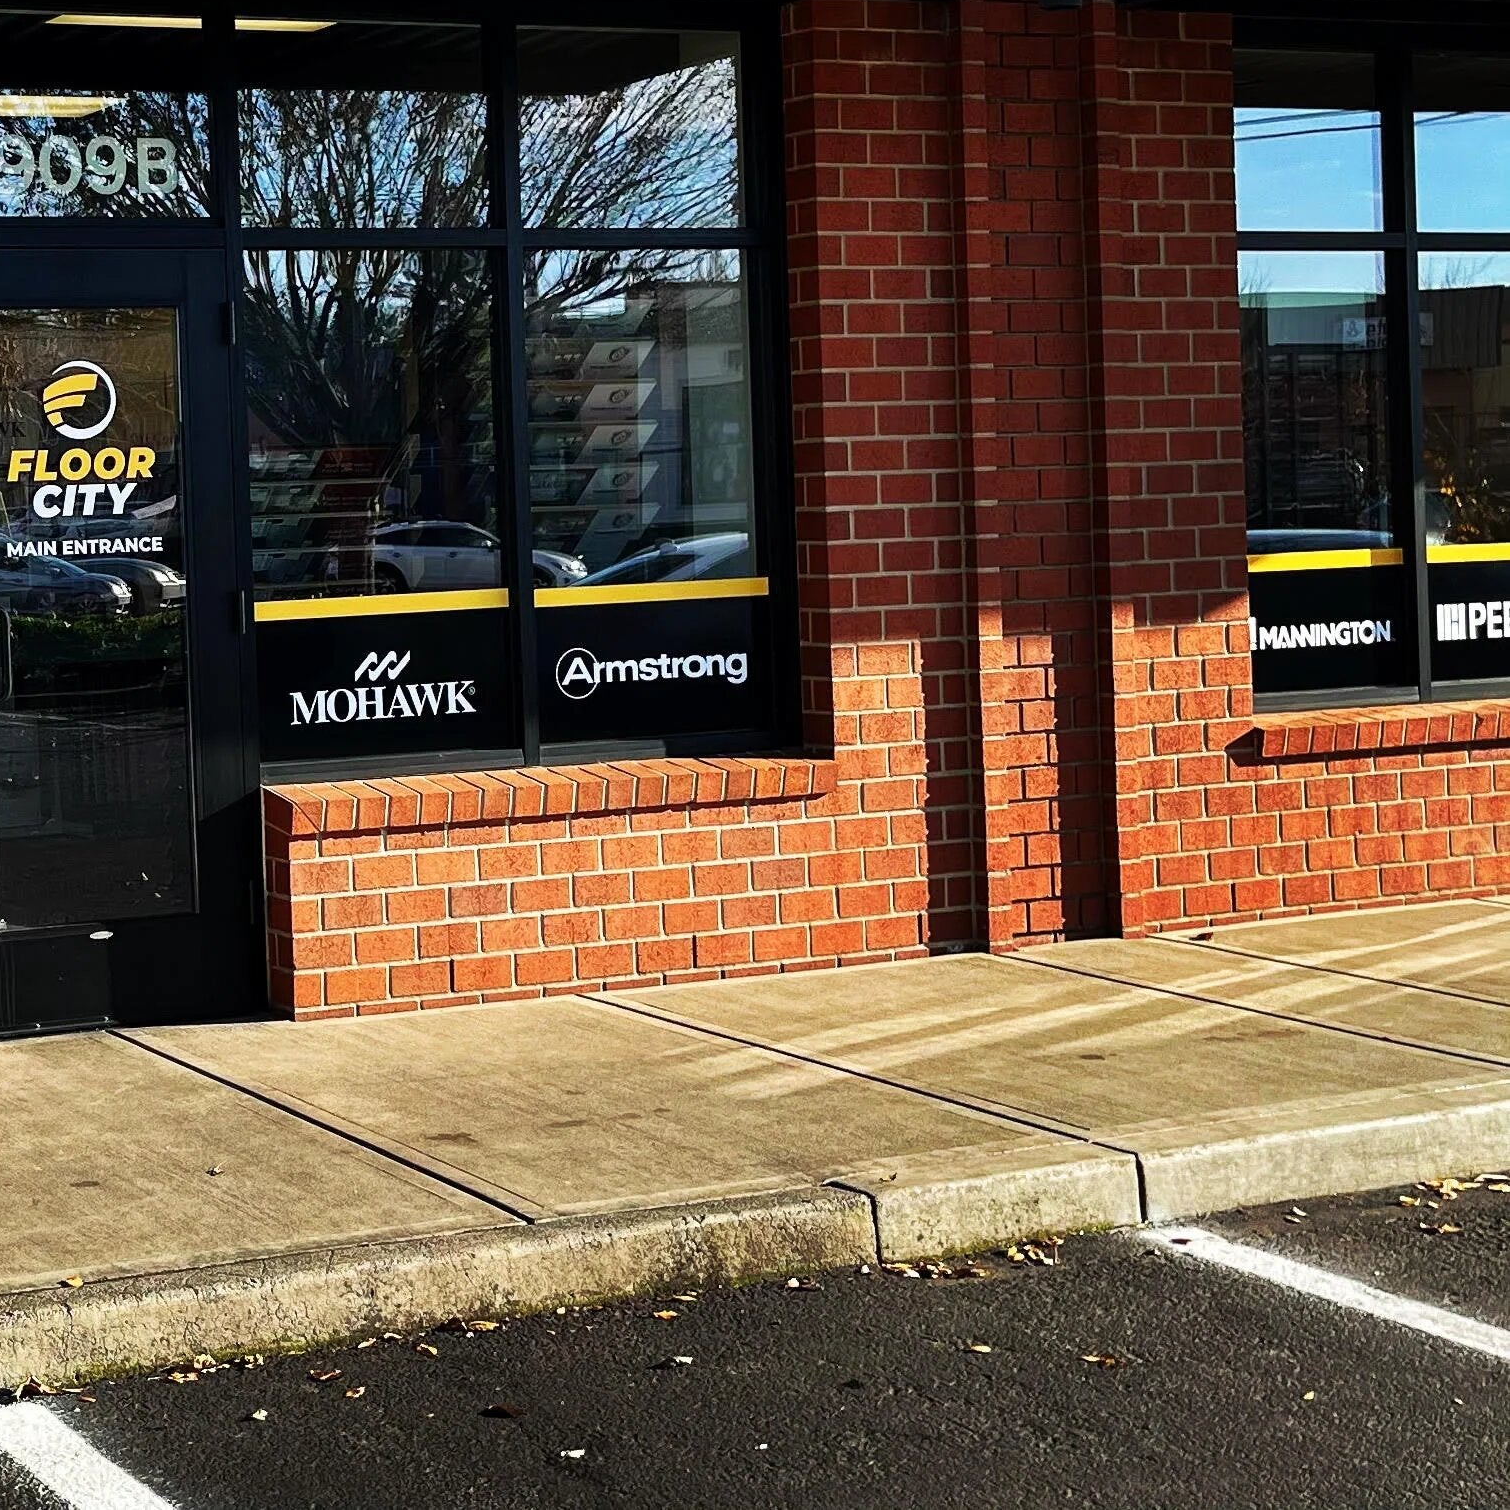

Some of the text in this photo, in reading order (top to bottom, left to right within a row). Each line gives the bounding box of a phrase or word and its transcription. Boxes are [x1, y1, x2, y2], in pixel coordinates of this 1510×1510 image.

[7, 446, 157, 482] FLOOR
[32, 482, 138, 519] CITY
[6, 536, 164, 558] MAIN ENTRANCE
[1258, 619, 1392, 651] MANNINGTON
[561, 651, 748, 688] Armstrong
[290, 679, 477, 726] MOHAWK
